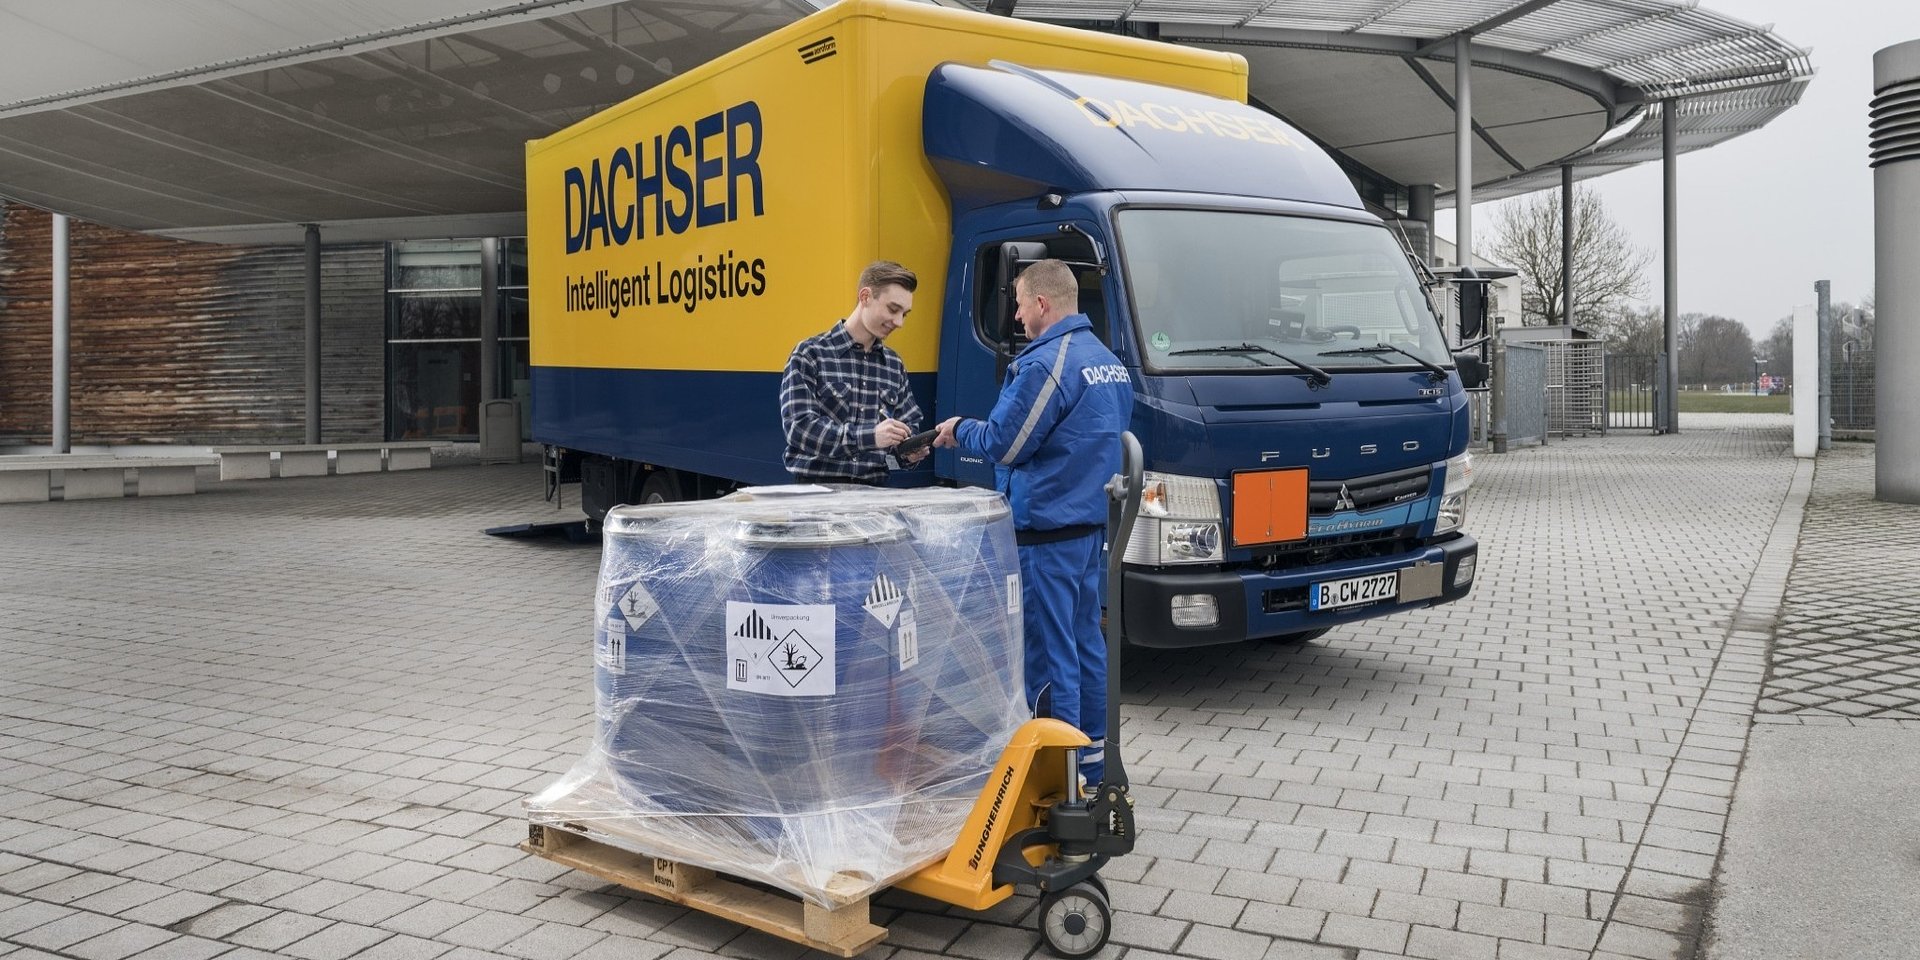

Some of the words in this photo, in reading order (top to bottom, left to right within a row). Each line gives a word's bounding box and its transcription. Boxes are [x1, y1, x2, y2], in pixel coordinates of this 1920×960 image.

[1075, 96, 1305, 151] DACHSER
[564, 100, 765, 255] DACHSER
[566, 264, 651, 318] Intelligent
[656, 250, 766, 313] Logistics
[1081, 364, 1132, 385] DACHSER
[1261, 440, 1420, 462] FUSO
[1320, 585, 1330, 605] B
[1340, 581, 1360, 602] CW
[1361, 575, 1396, 599] 2727
[968, 765, 1015, 871] JUNGHEINRICH
